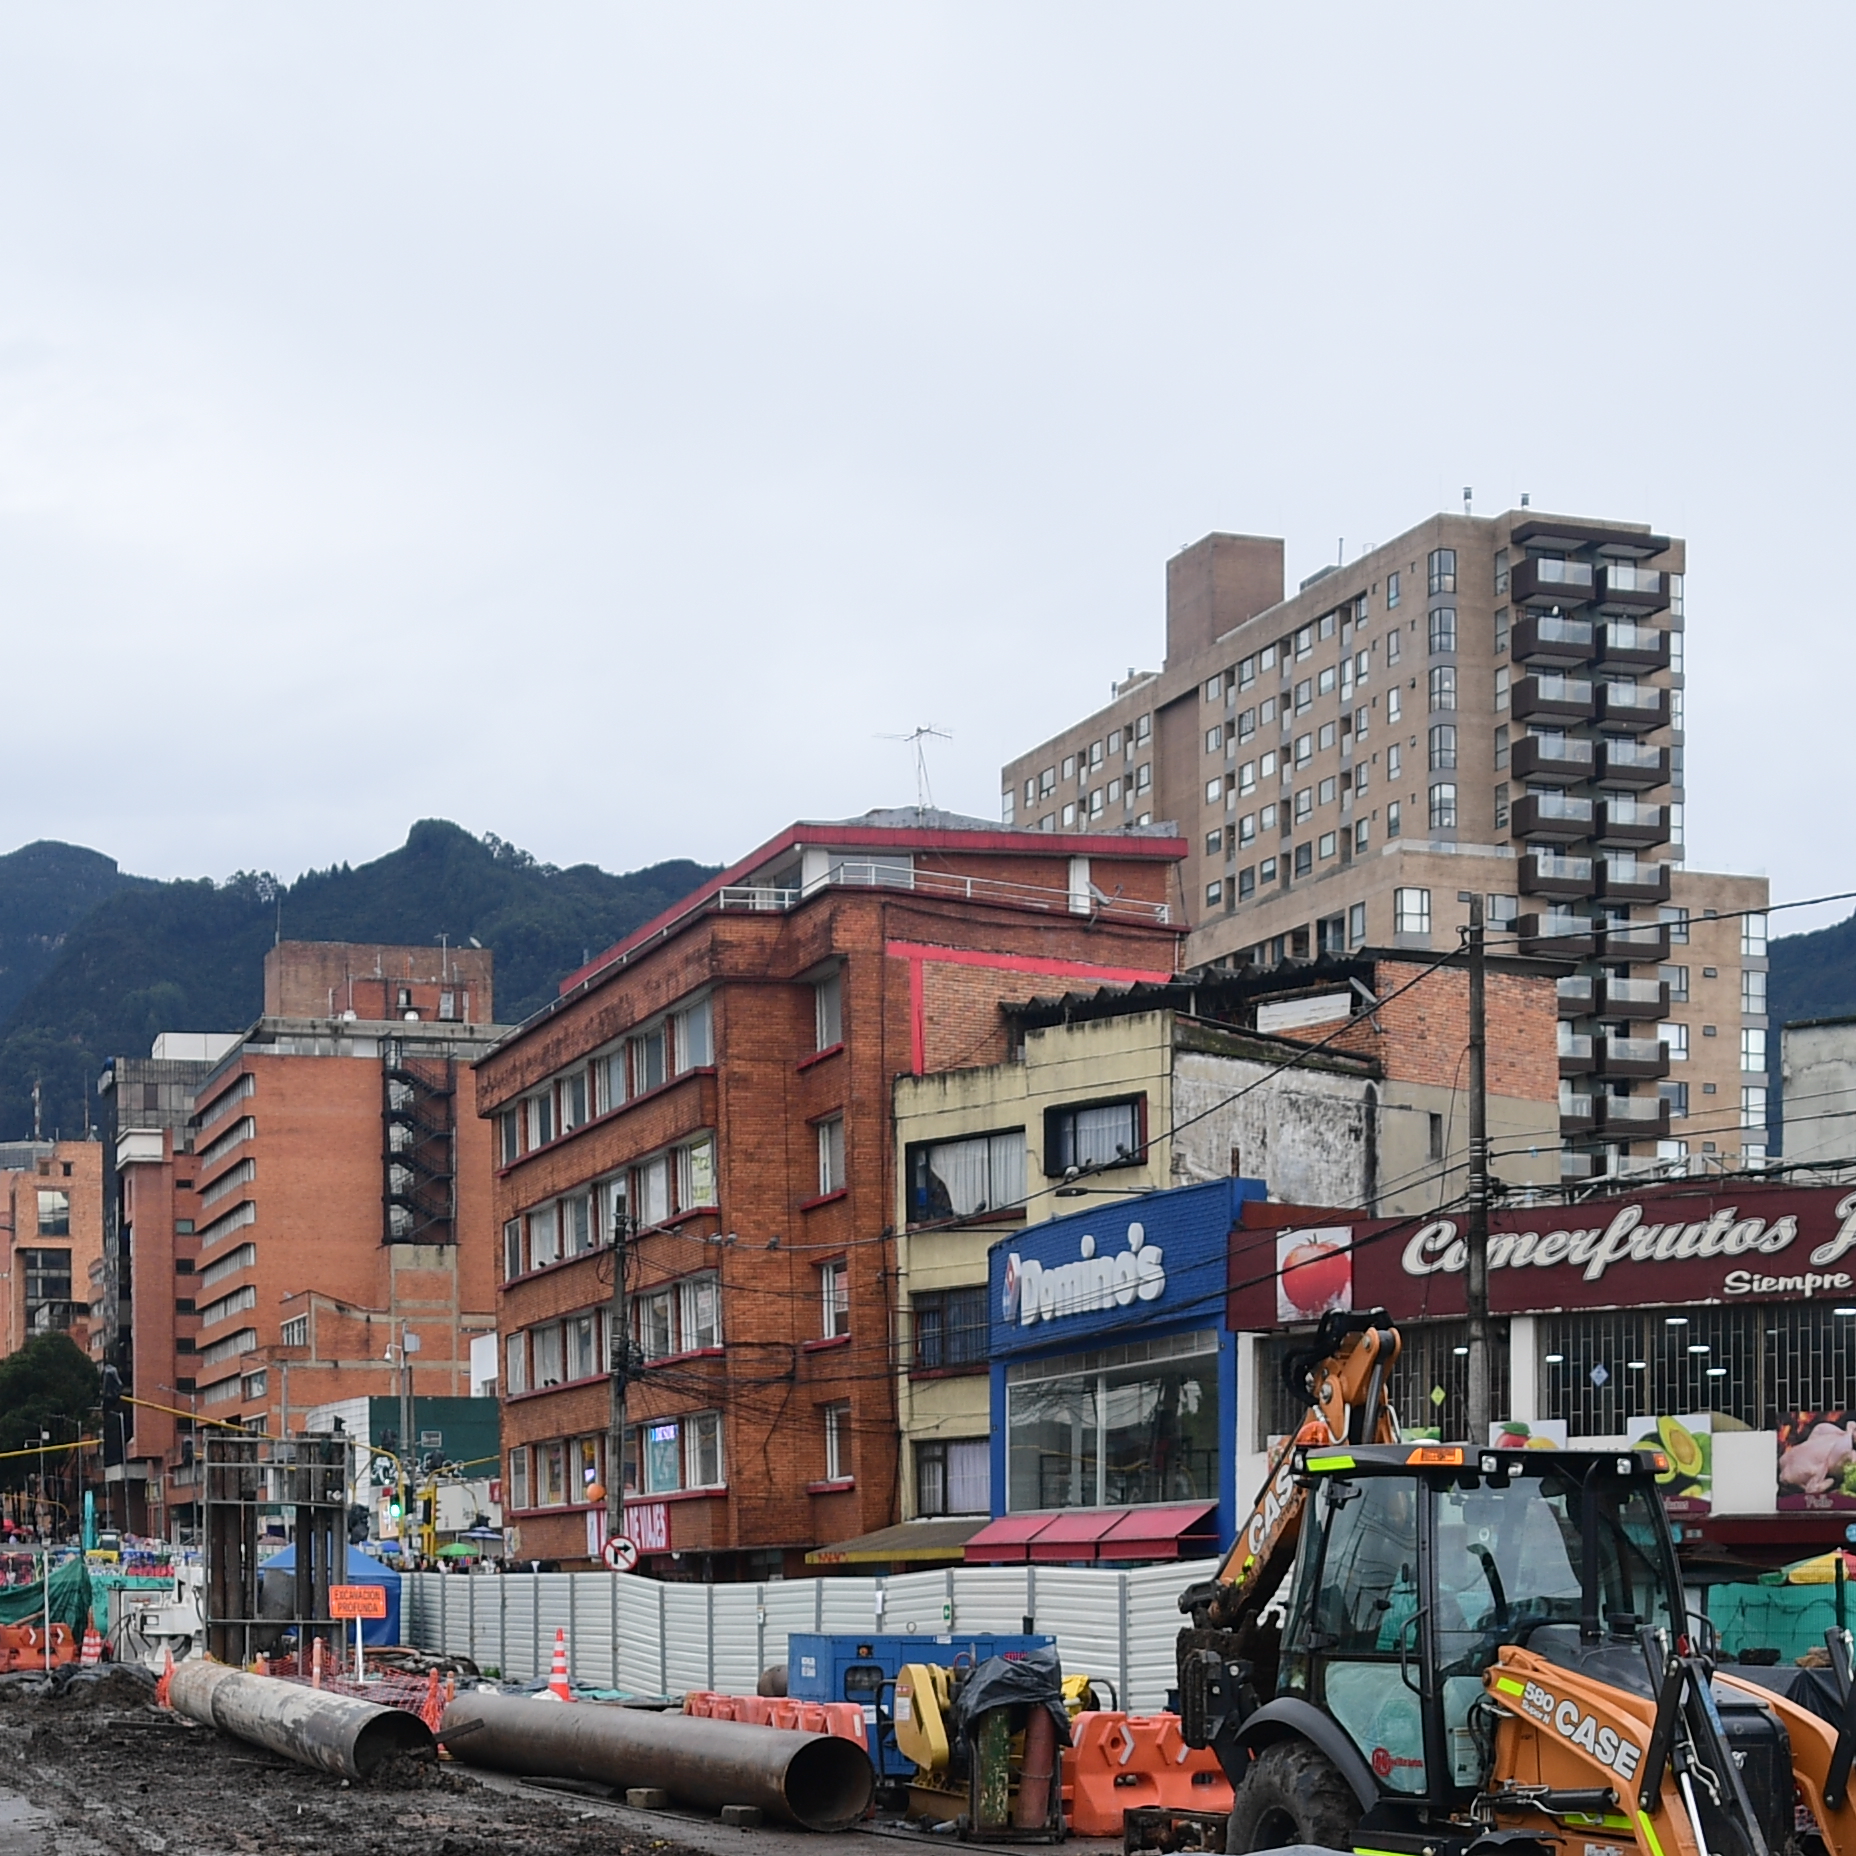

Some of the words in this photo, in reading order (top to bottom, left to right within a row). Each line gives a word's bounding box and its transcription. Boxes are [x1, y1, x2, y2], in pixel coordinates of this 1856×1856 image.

[1021, 1222, 1166, 1326] Domino's
[1402, 1204, 1797, 1281] Comerfrutos
[1724, 1270, 1853, 1297] Siempre
[1248, 1446, 1296, 1555] CAS
[1524, 1681, 1555, 1712] 580
[1555, 1700, 1642, 1780] CASE
